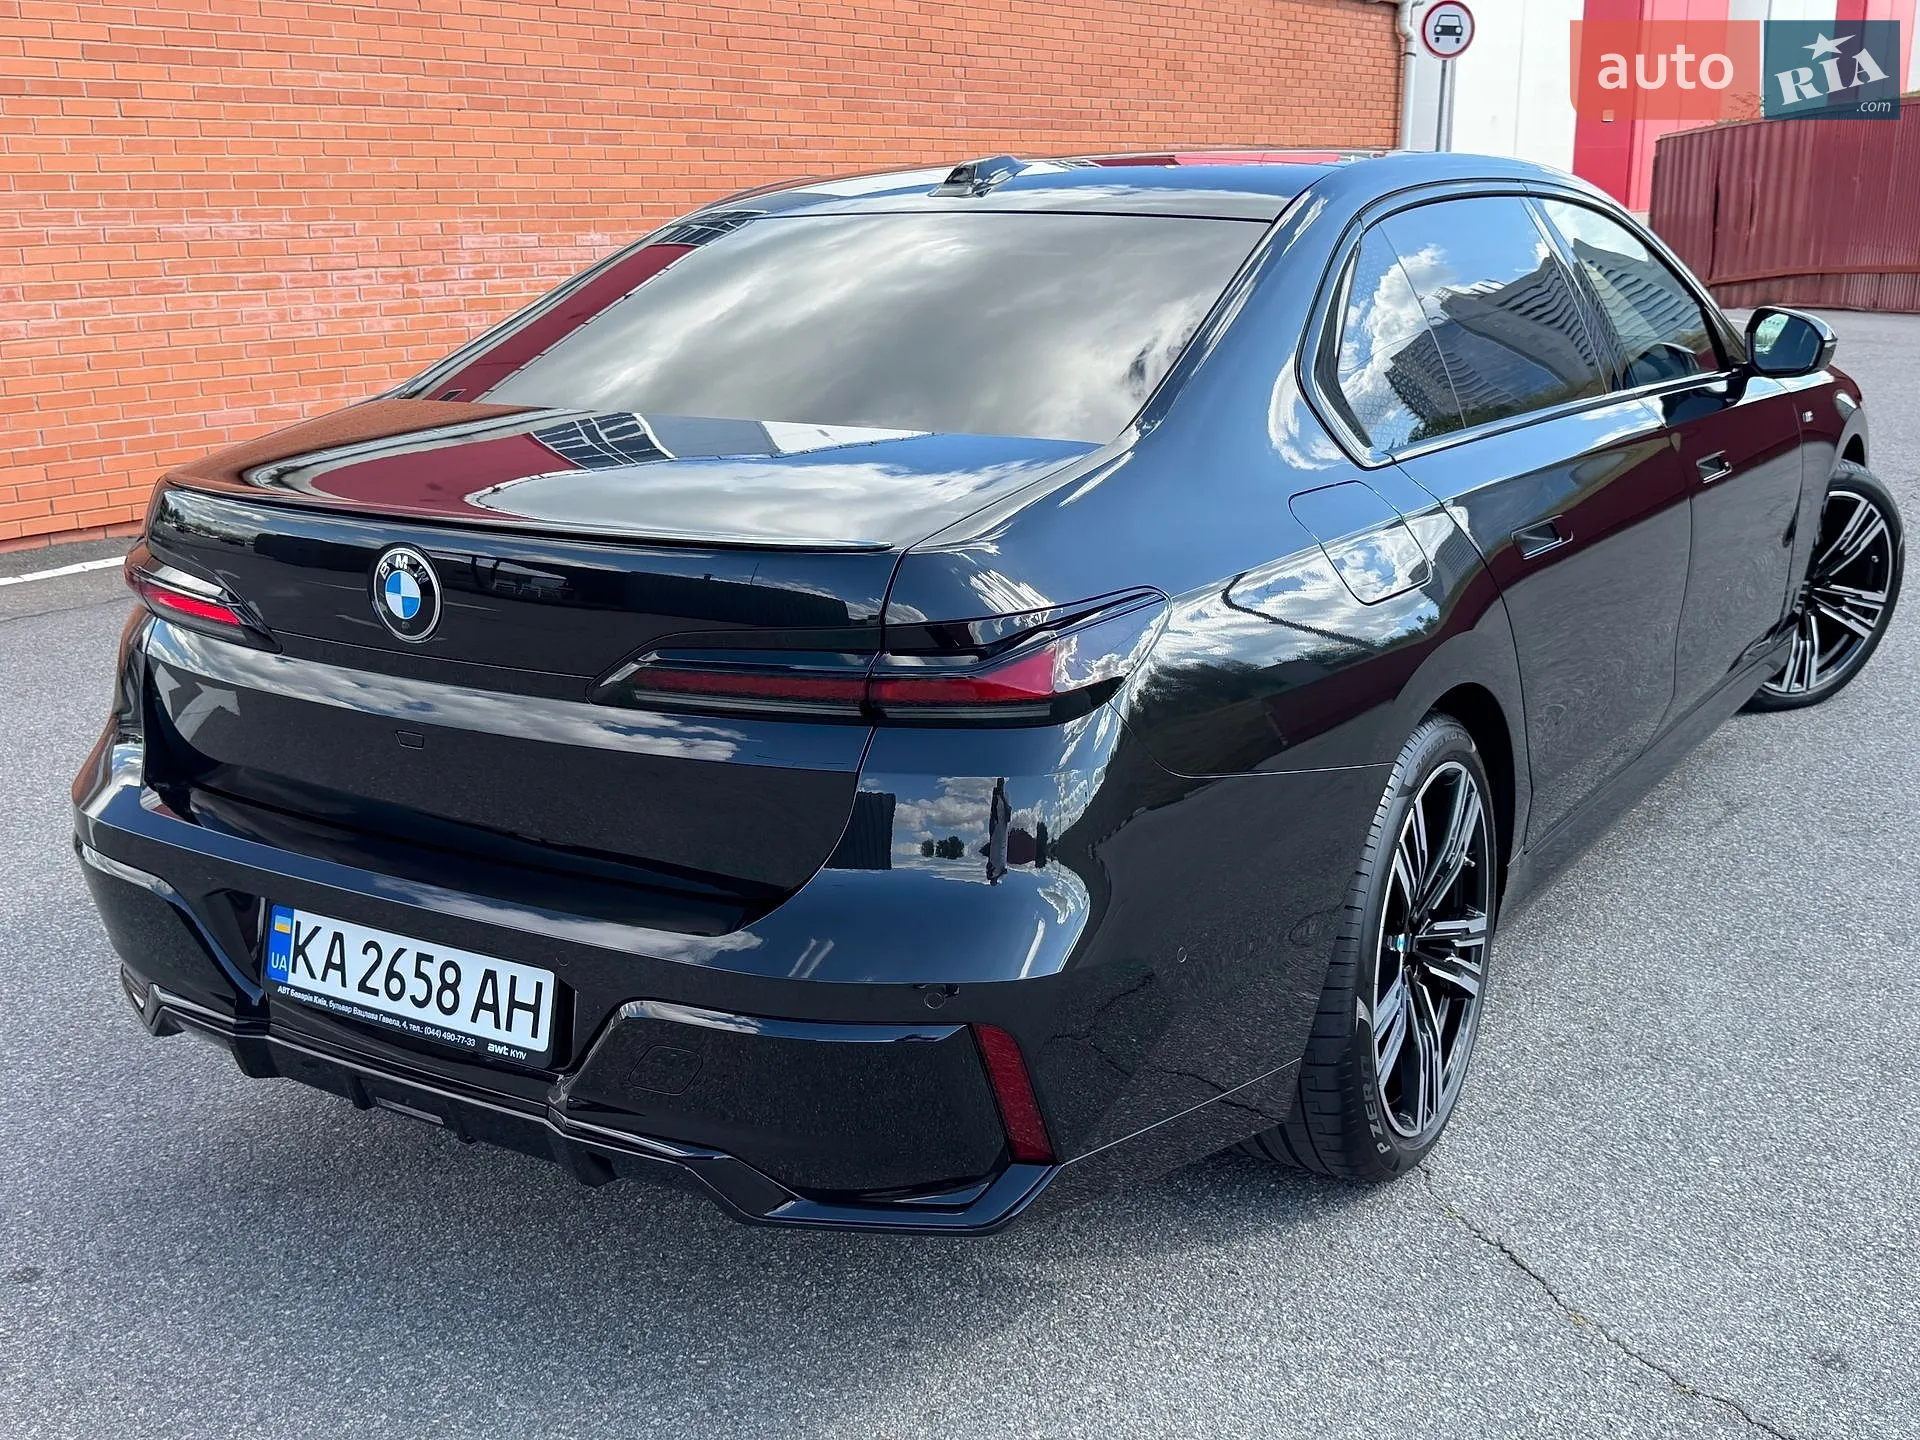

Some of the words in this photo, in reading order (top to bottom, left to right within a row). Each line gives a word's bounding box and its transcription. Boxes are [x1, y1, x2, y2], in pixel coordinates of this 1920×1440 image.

[380, 554, 430, 585] BMW
[271, 952, 288, 972] UA
[291, 920, 348, 988] KA
[357, 940, 462, 1016] 2658
[470, 968, 544, 1039] AH
[402, 1021, 408, 1030] 4,
[424, 1026, 441, 1039] (044)
[442, 1031, 476, 1047] 490-77-33
[487, 1043, 509, 1056] awt
[509, 1048, 527, 1060] KYIV
[1376, 1142, 1391, 1154] P
